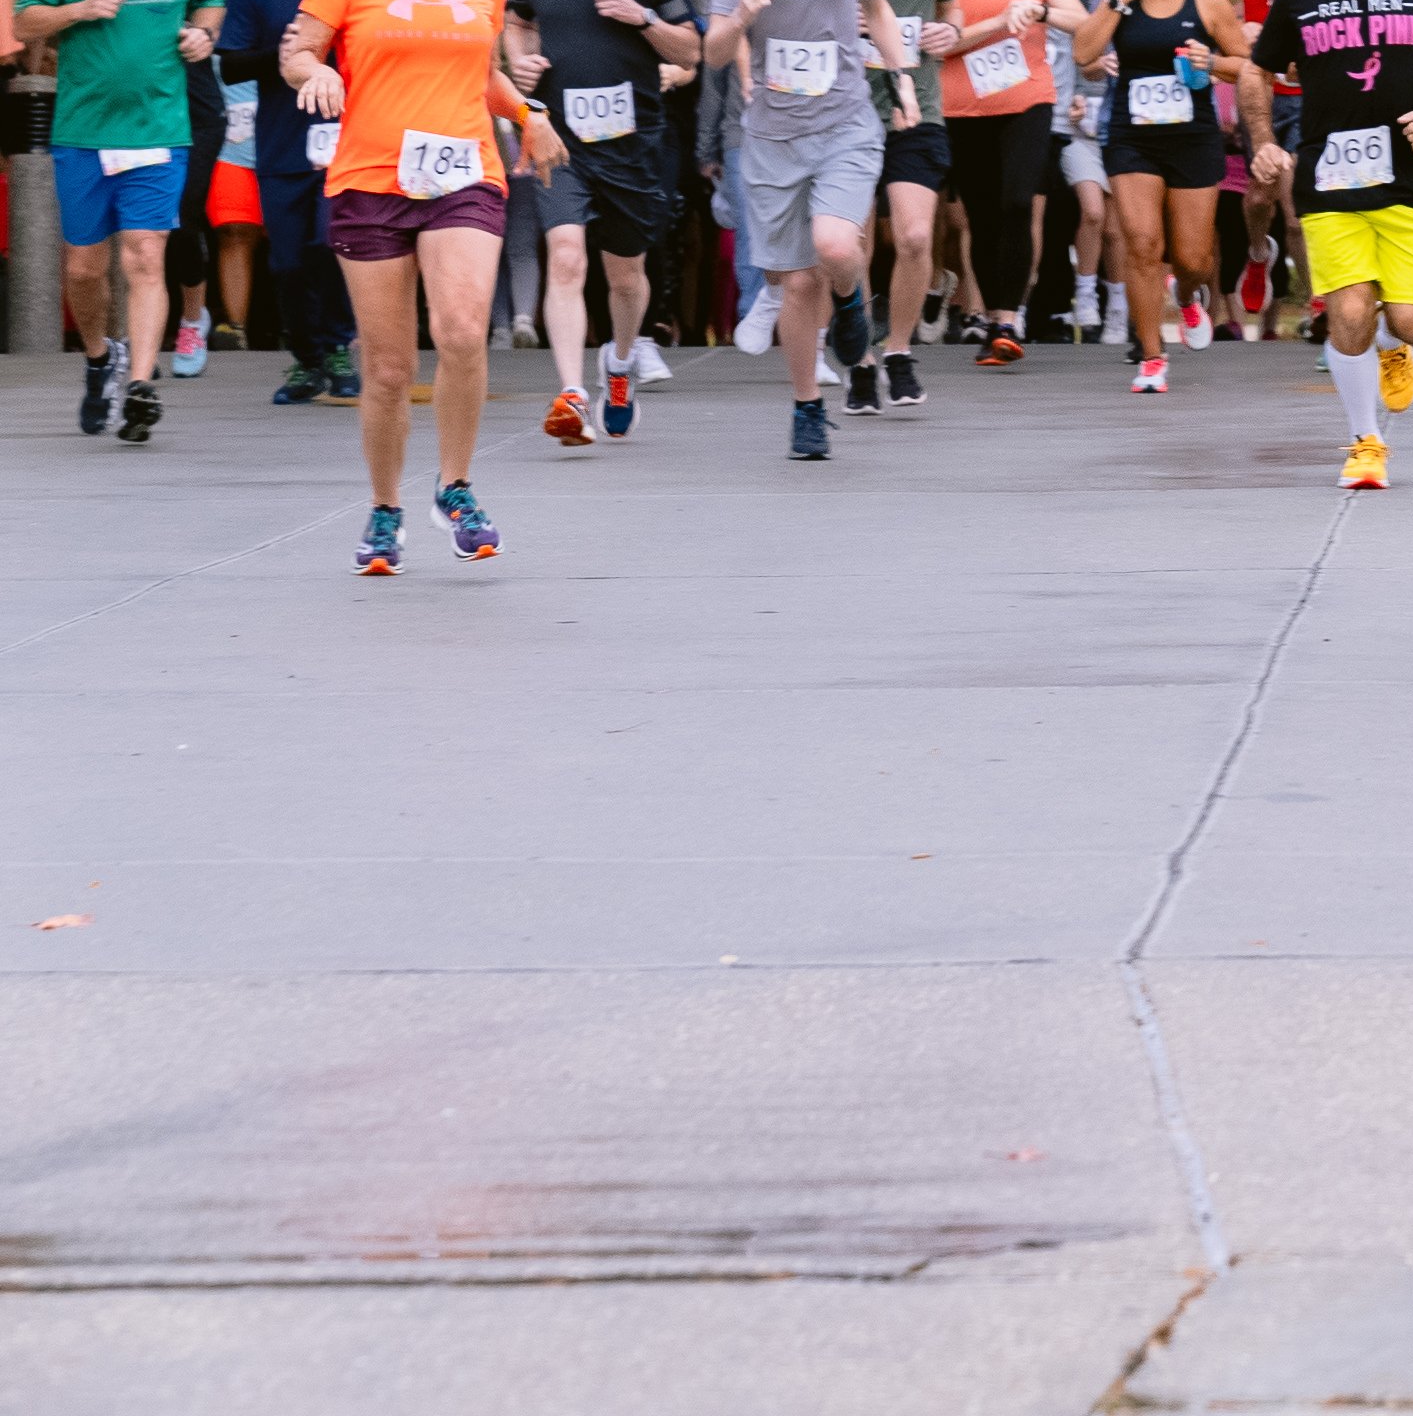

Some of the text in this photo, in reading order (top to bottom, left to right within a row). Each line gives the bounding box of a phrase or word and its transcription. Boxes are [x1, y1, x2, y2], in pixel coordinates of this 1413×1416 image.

[1318, 0, 1363, 18] REAL
[1301, 17, 1364, 56] ROCK
[773, 47, 828, 71] 121
[971, 44, 1020, 77] 096
[572, 91, 627, 119] 005
[1136, 81, 1185, 105] 036
[414, 142, 472, 175] 184
[1325, 135, 1383, 165] 066
